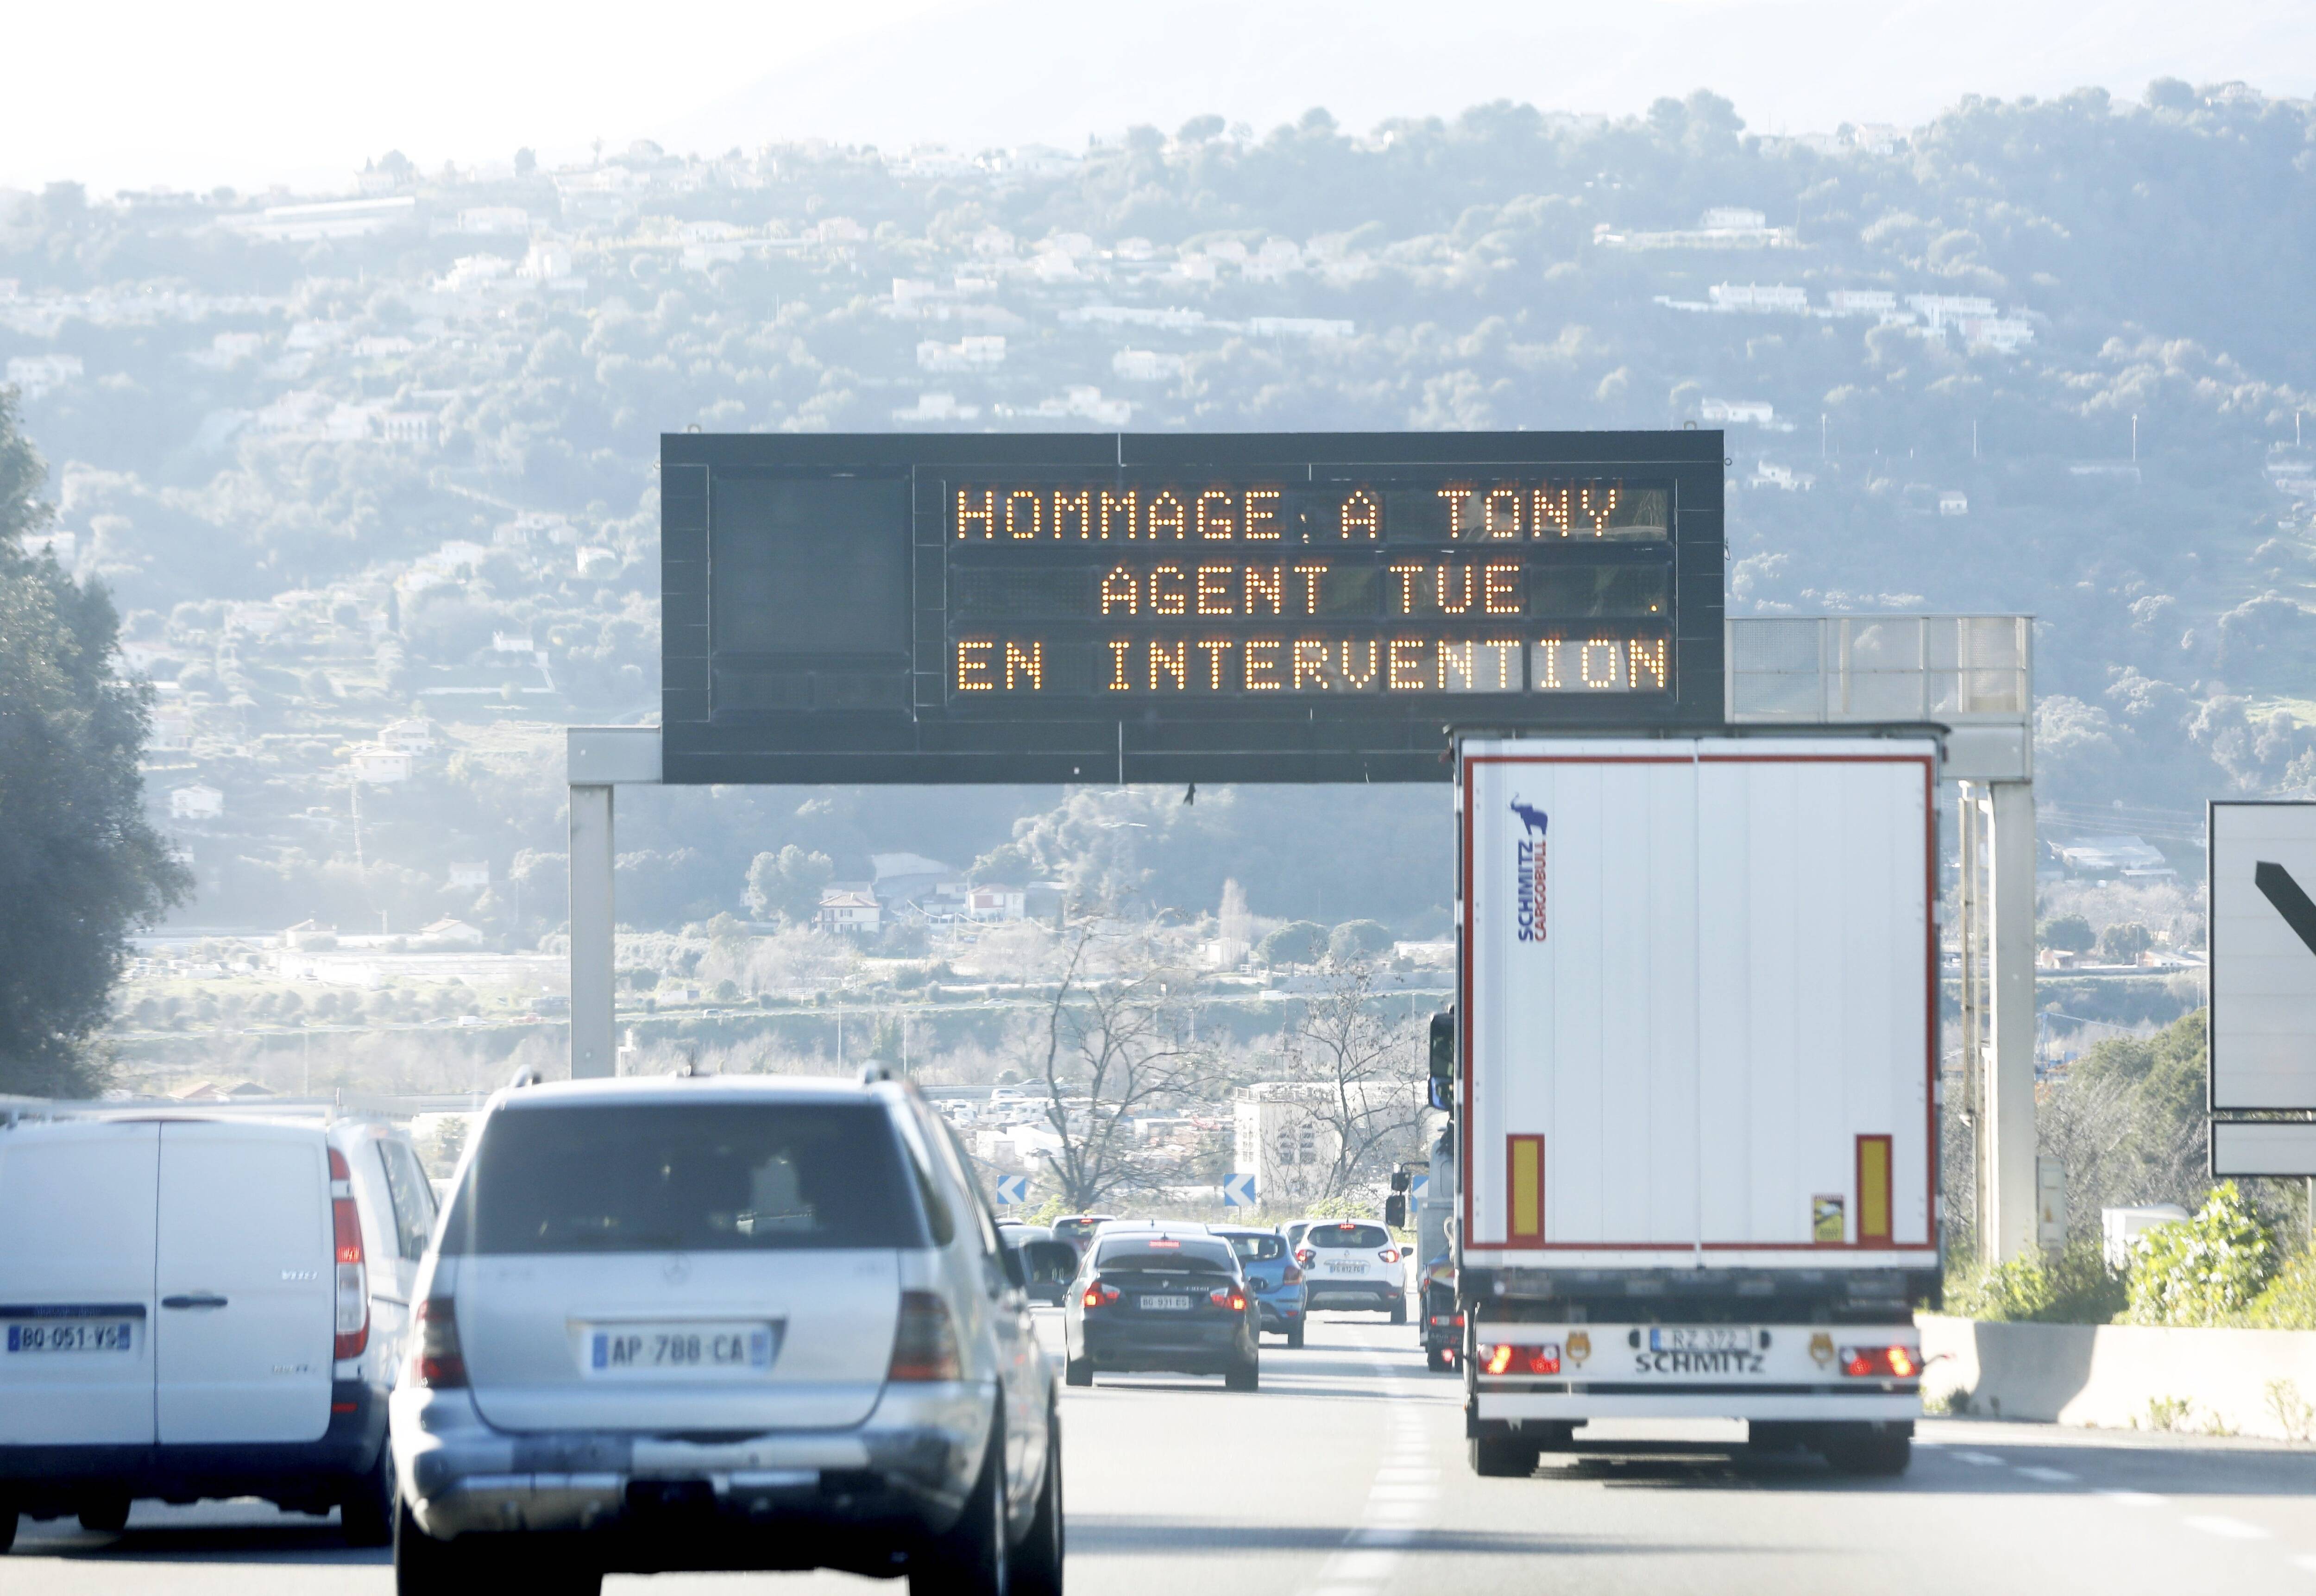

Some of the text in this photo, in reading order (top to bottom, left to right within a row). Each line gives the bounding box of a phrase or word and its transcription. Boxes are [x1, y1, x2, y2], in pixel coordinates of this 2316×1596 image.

[957, 490, 1617, 539] HOMMAGE A TONY
[1101, 565, 1521, 615] AGENT TUE
[957, 640, 1665, 690] EN INTERVENTION
[1518, 839, 1533, 942] SCHMITZ
[1534, 840, 1547, 942] CARGOBULL
[1635, 1352, 1765, 1373] SCHMITZ
